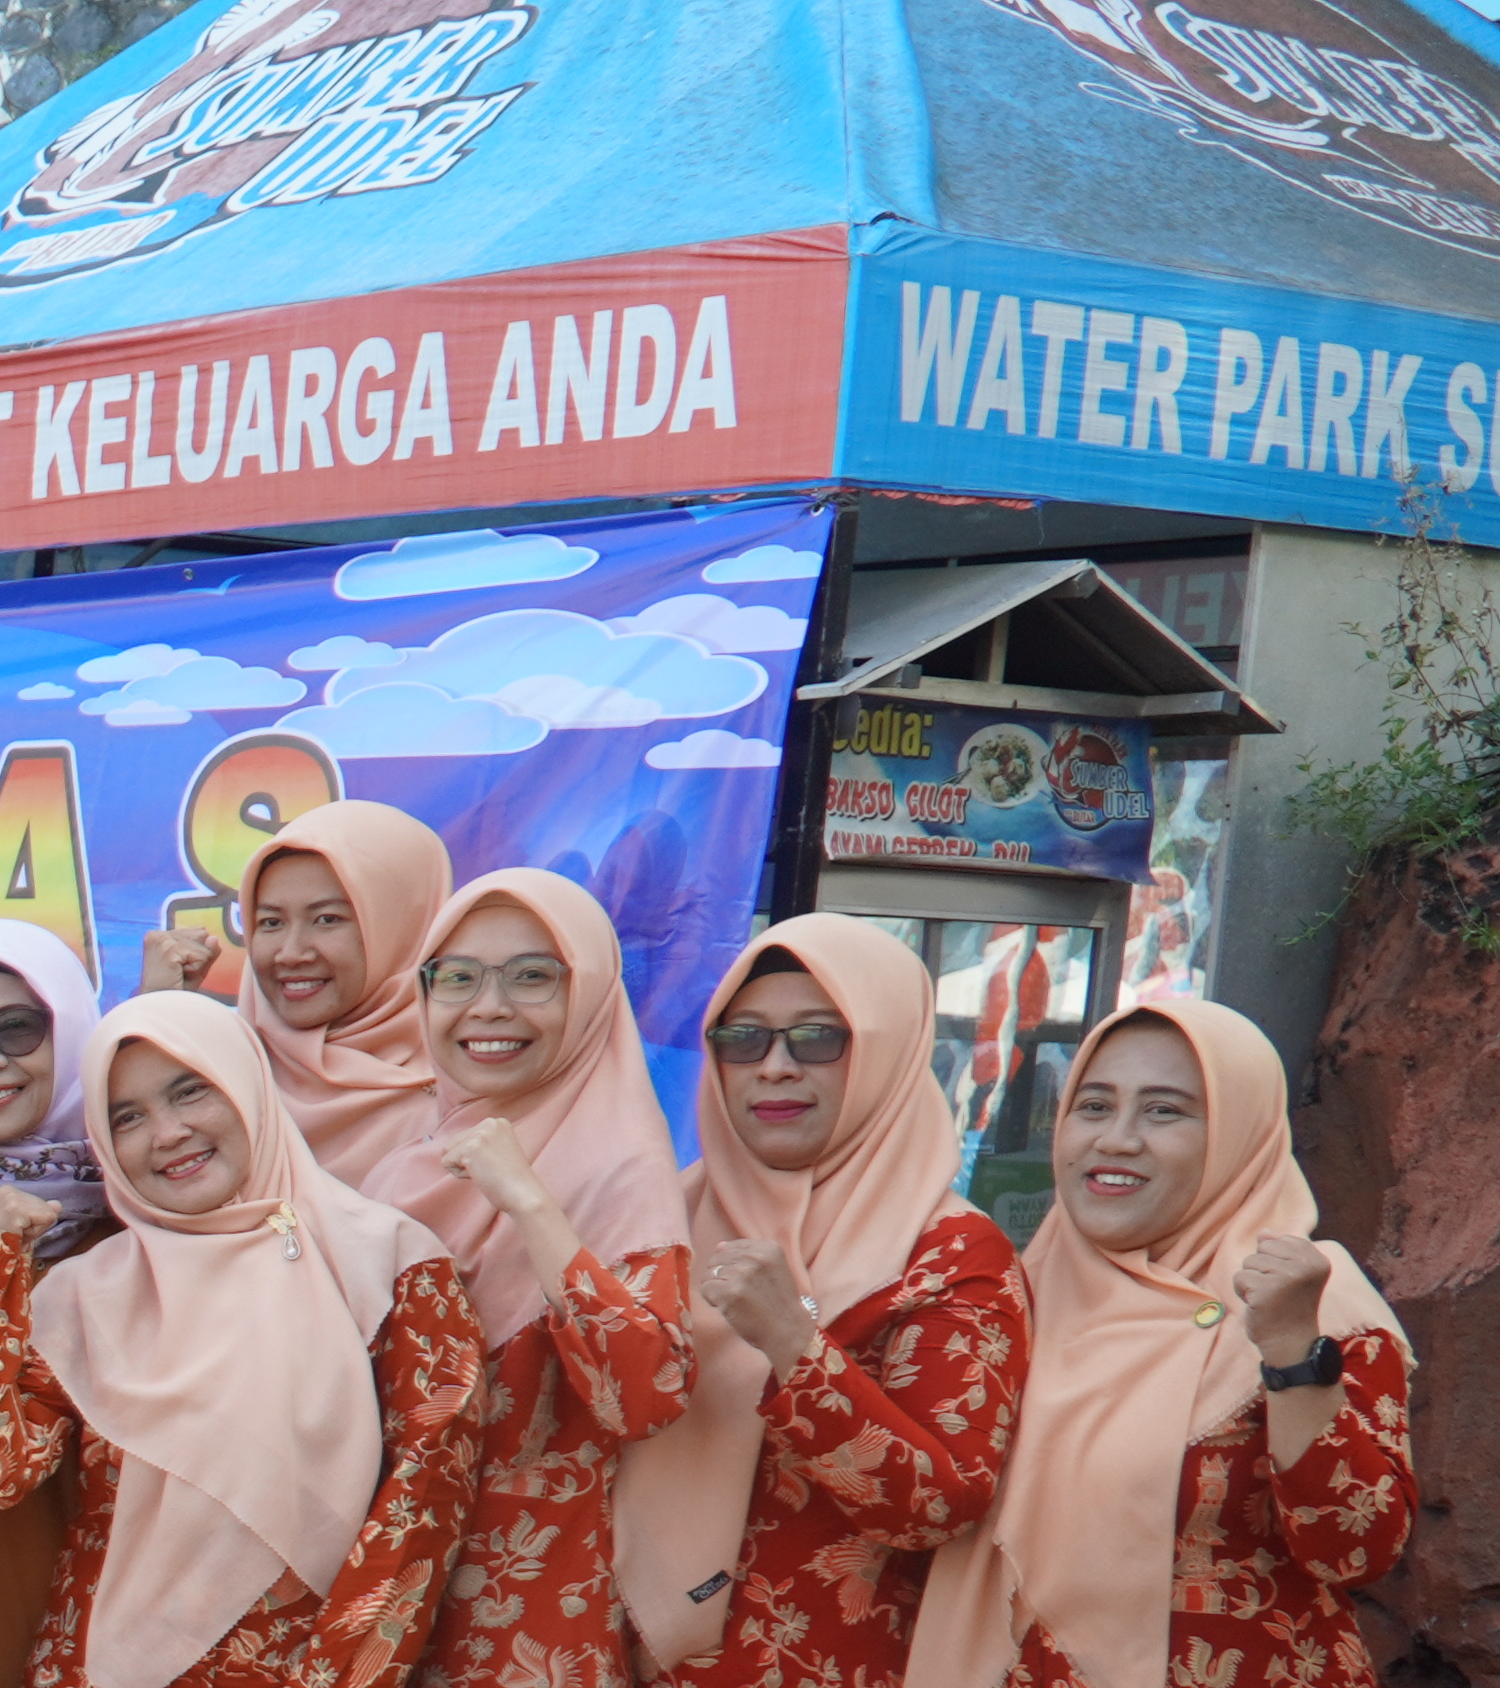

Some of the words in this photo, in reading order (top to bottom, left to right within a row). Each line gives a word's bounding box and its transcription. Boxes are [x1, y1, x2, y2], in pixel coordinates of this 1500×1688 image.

[31, 332, 453, 501] KELUARGA
[478, 295, 737, 452] ANDA
[900, 281, 1189, 454] WATER
[1208, 328, 1423, 484] PARK
[832, 704, 933, 758] edia:
[825, 777, 894, 820] BAKSO
[1070, 759, 1128, 791] SUMBER
[1102, 789, 1150, 820] UDEL
